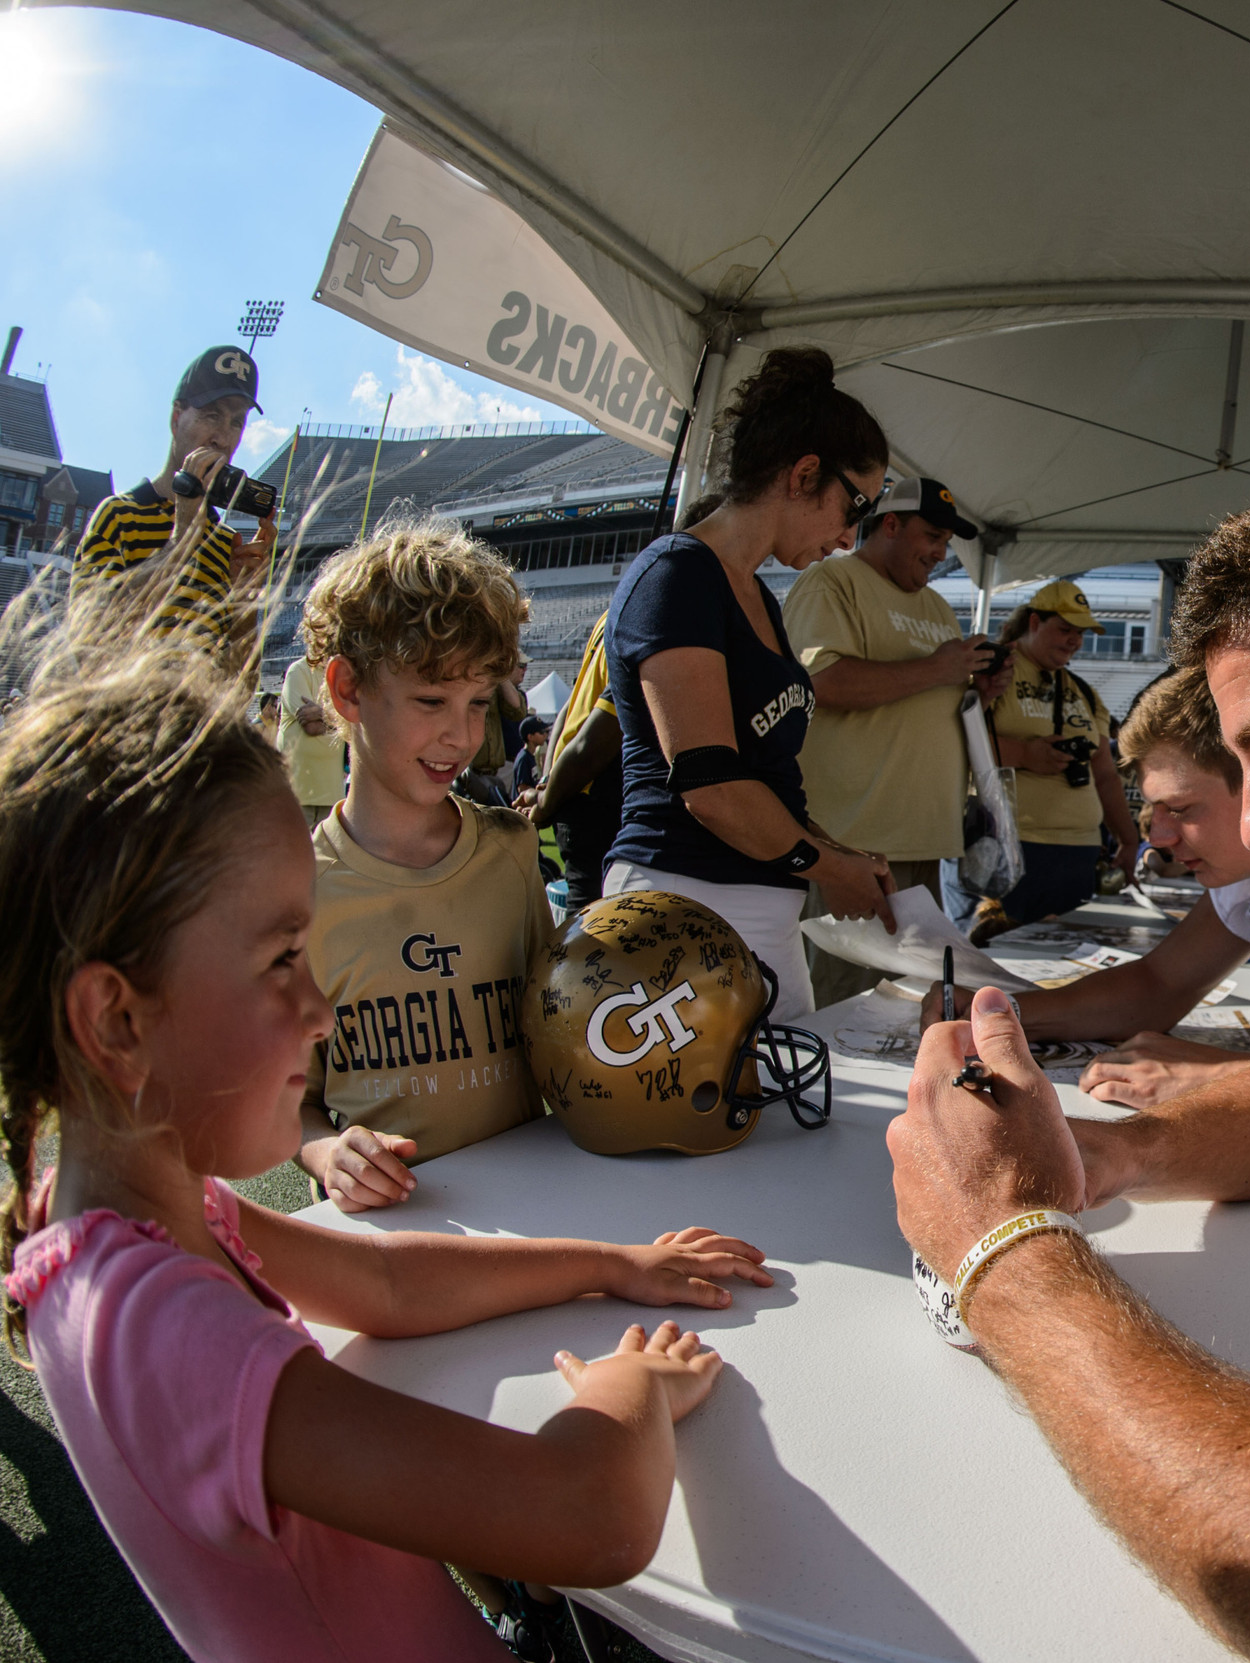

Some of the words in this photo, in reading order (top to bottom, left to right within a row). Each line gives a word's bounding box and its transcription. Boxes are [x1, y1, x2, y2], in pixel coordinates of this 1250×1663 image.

[215, 351, 251, 382] GT
[401, 932, 462, 978] GT
[586, 979, 698, 1068] GT
[363, 1074, 438, 1100] YELLOW
[981, 1212, 1048, 1253] COMPETE
